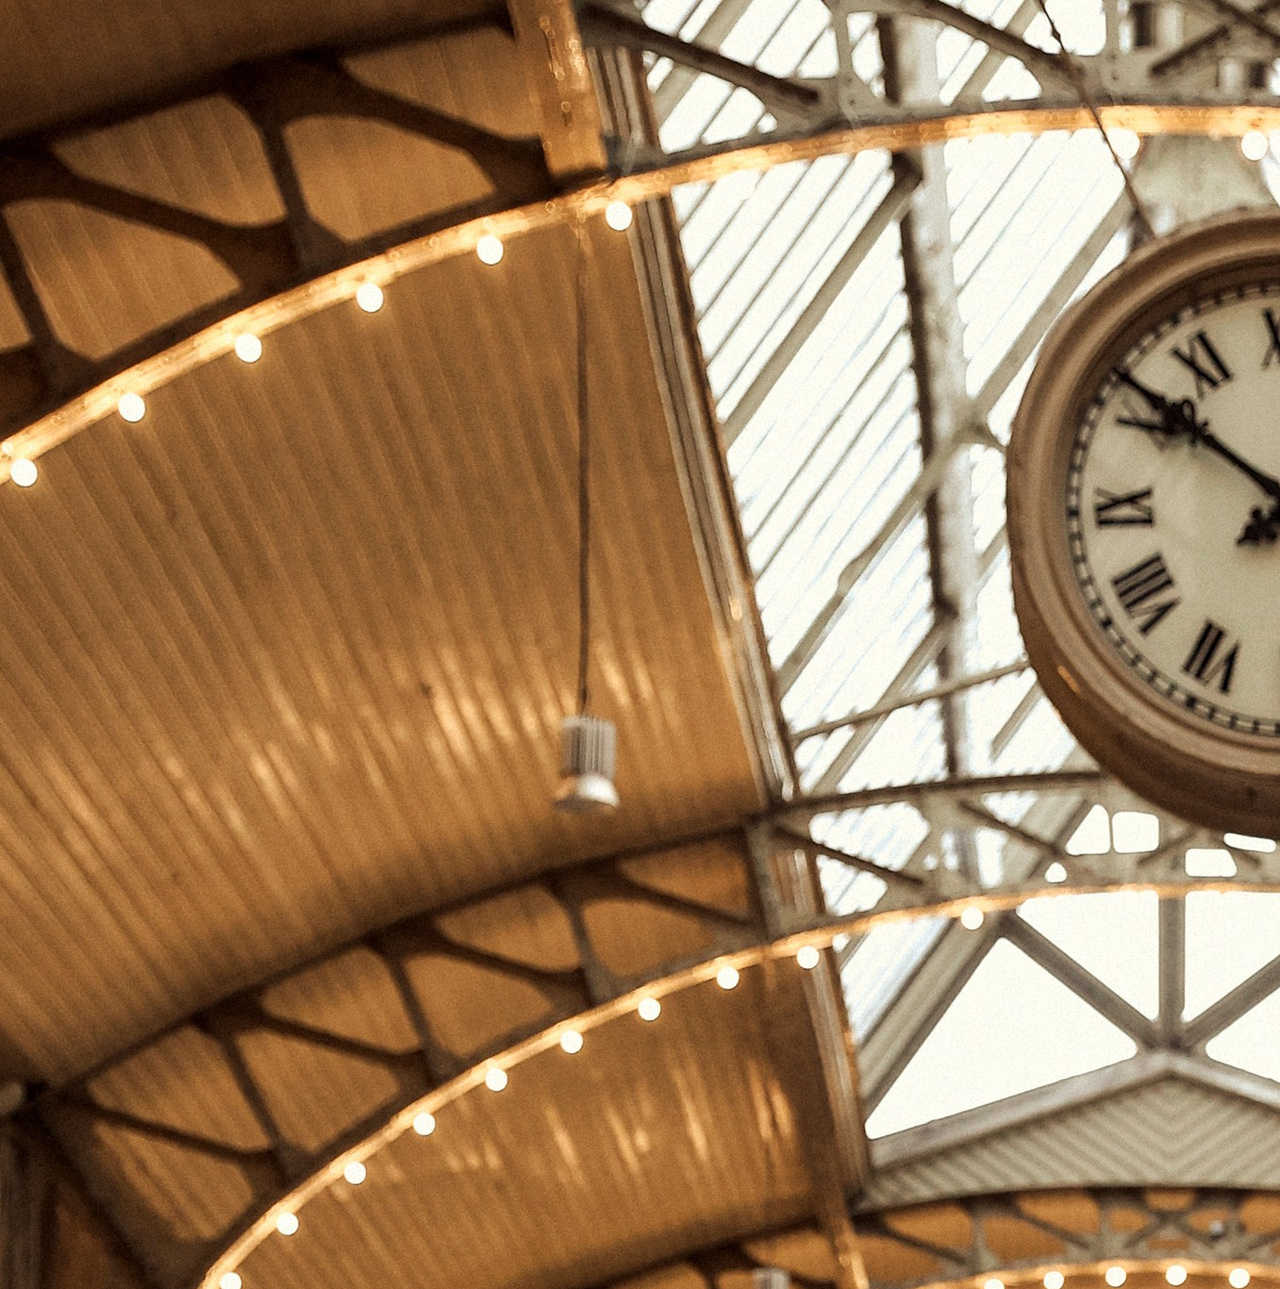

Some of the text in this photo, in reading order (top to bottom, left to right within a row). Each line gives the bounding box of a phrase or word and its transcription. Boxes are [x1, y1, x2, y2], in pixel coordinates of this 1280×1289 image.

[1171, 331, 1231, 397] XI
[1094, 487, 1155, 529] IX
[1111, 554, 1182, 636] VIII
[1182, 619, 1241, 695] VII
